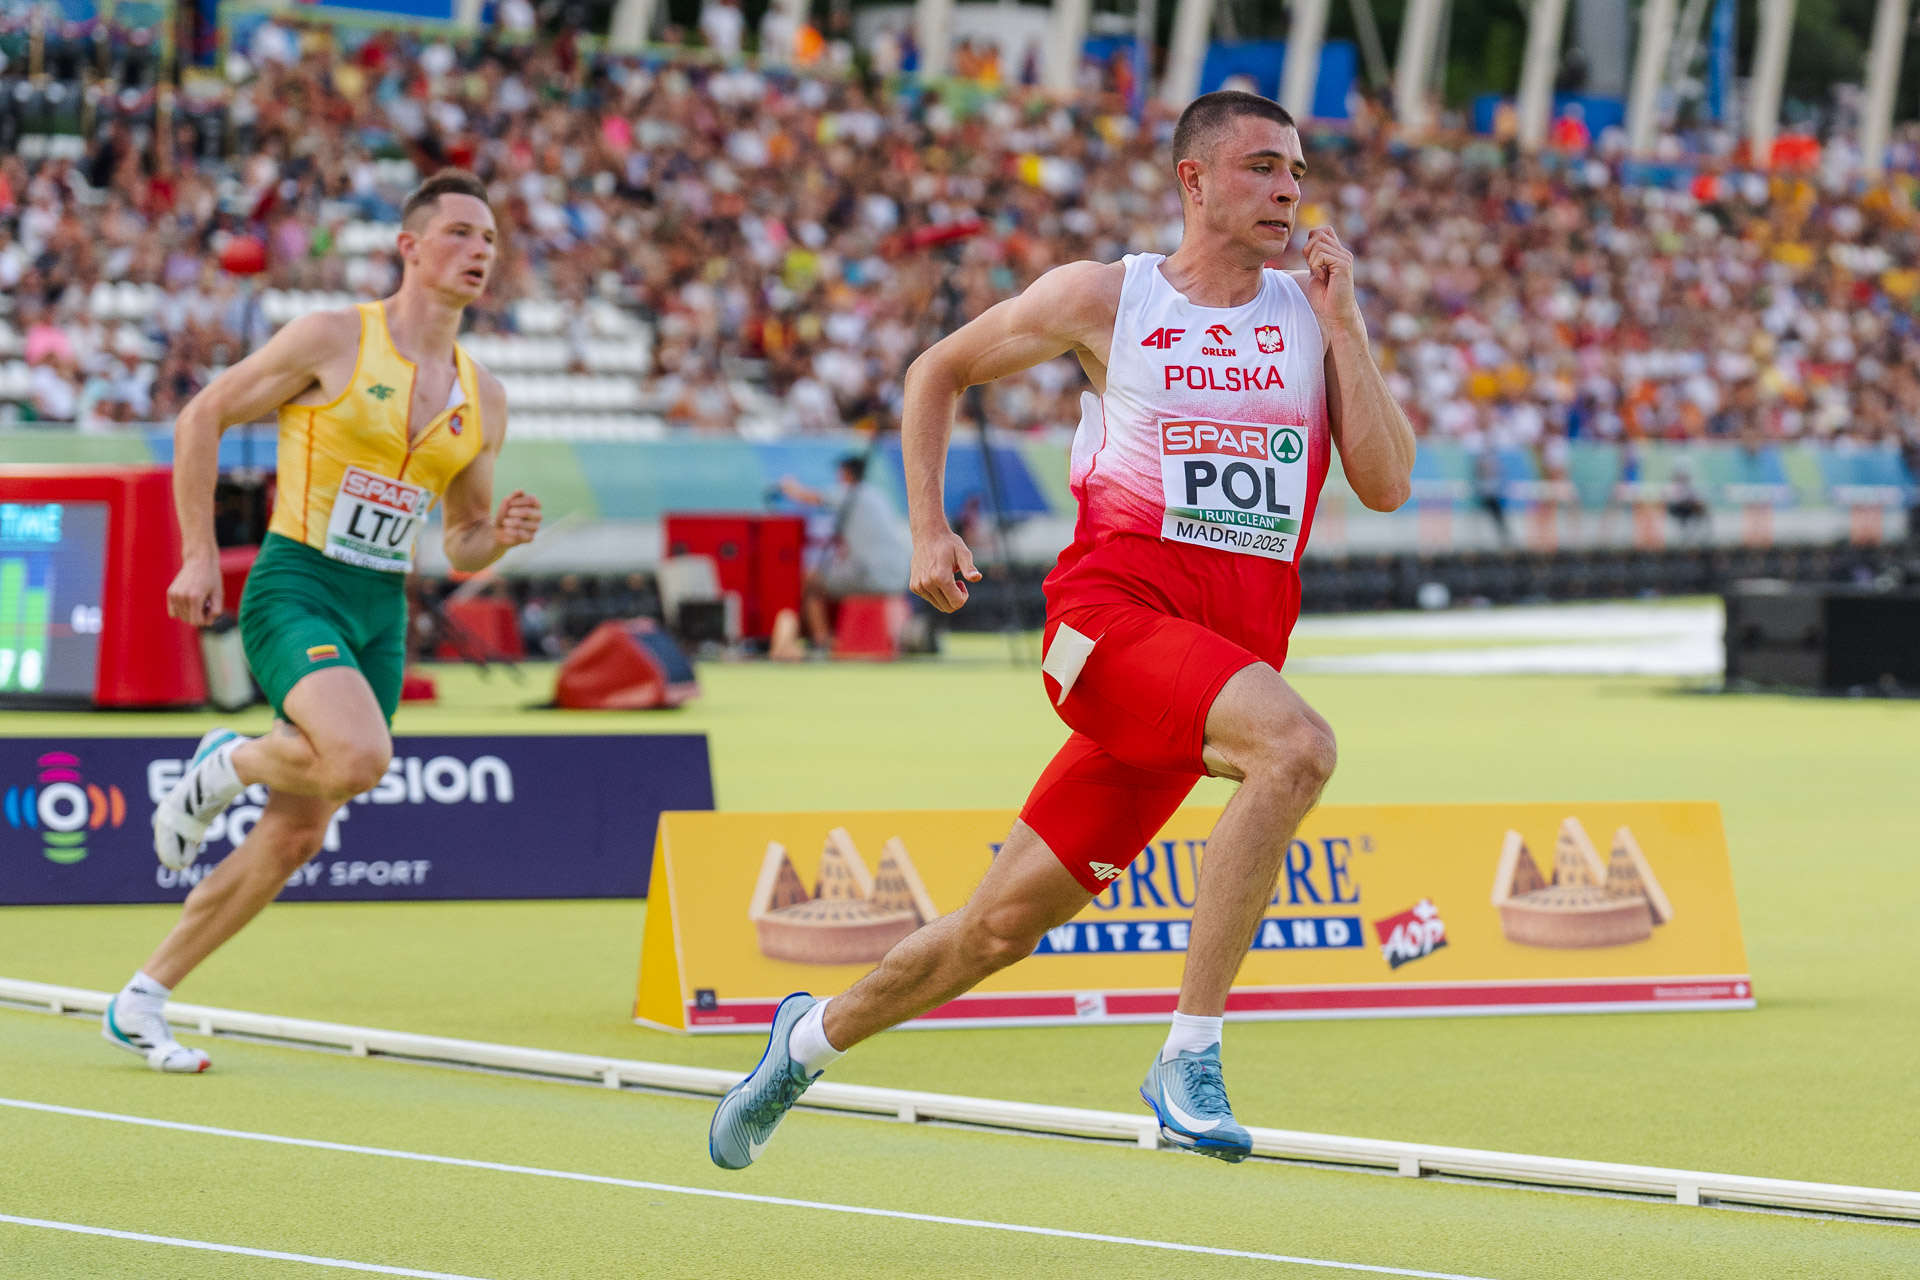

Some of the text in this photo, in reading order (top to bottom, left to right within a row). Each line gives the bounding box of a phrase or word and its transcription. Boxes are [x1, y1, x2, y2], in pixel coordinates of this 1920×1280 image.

[1141, 328, 1186, 349] 4F
[1202, 347, 1236, 357] ORLEN
[1165, 365, 1285, 392] POLSKA
[1166, 425, 1265, 455] SPAR
[345, 473, 416, 511] SPAR
[1184, 461, 1291, 515] POL
[347, 504, 413, 546] LTU
[1206, 510, 1235, 523] RUN
[1176, 522, 1288, 553] MADRID 2025
[329, 860, 432, 886] SPORT
[1089, 861, 1123, 881] 4F
[1046, 920, 1351, 951] WITZEAND
